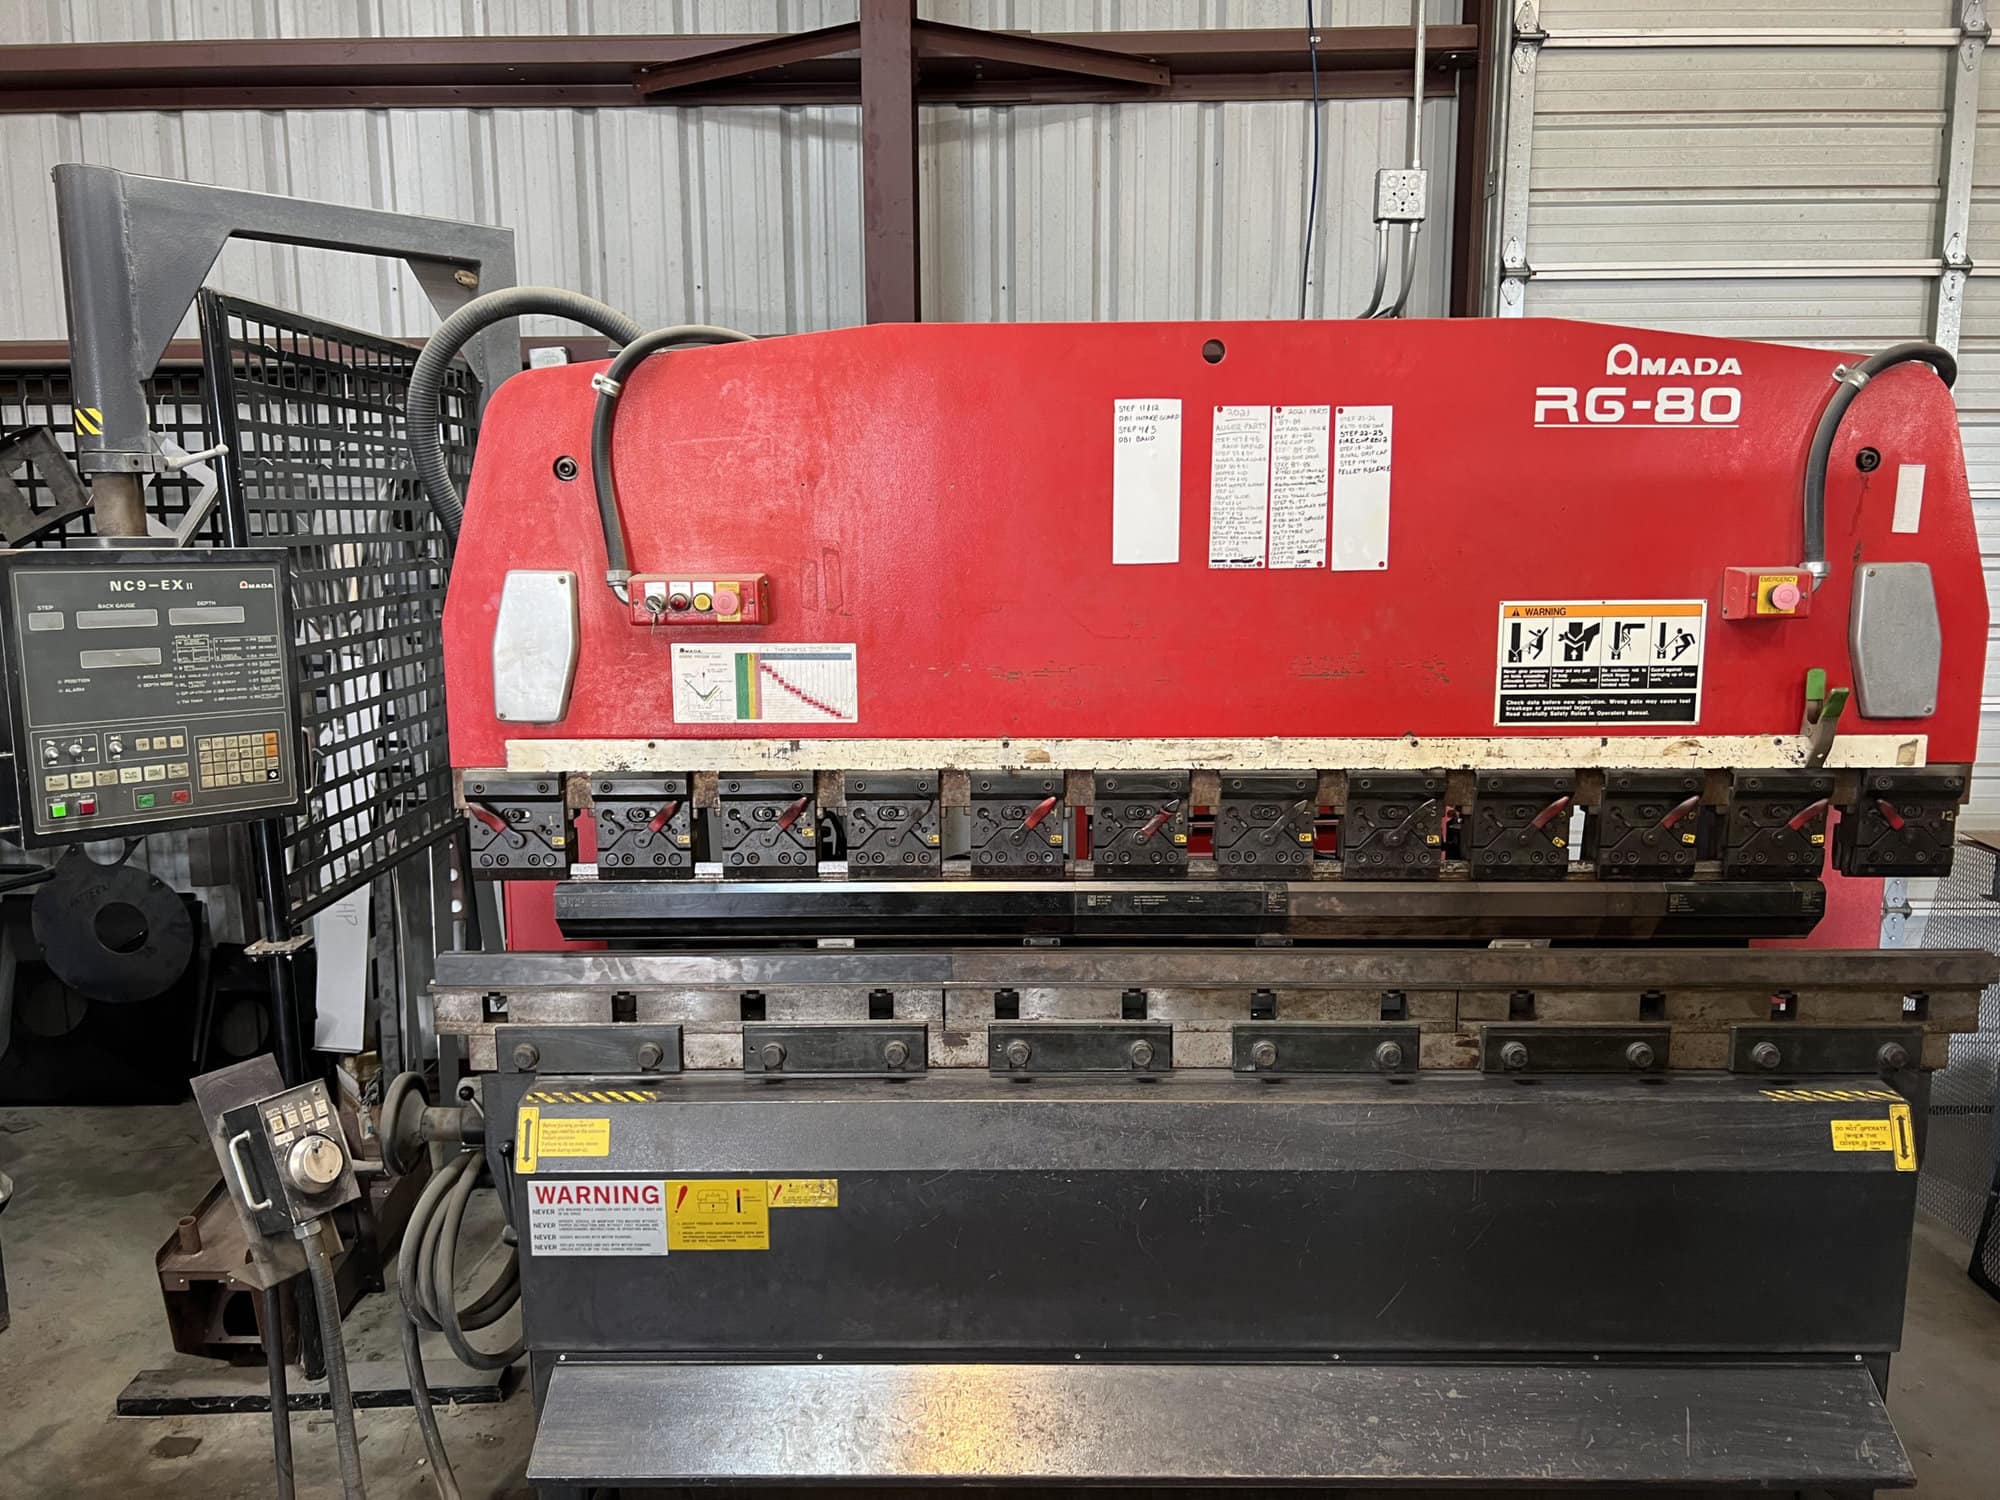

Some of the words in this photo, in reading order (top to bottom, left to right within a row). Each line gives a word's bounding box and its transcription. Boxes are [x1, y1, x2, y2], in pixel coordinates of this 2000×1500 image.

[1606, 343, 1743, 376] AMADA
[1534, 386, 1742, 423] RG-80
[1226, 408, 1250, 417] 2021
[1340, 430, 1358, 438] STEP
[1525, 607, 1566, 617] WARNING
[535, 1185, 660, 1205] WARNING
[532, 1208, 555, 1216] NEVER
